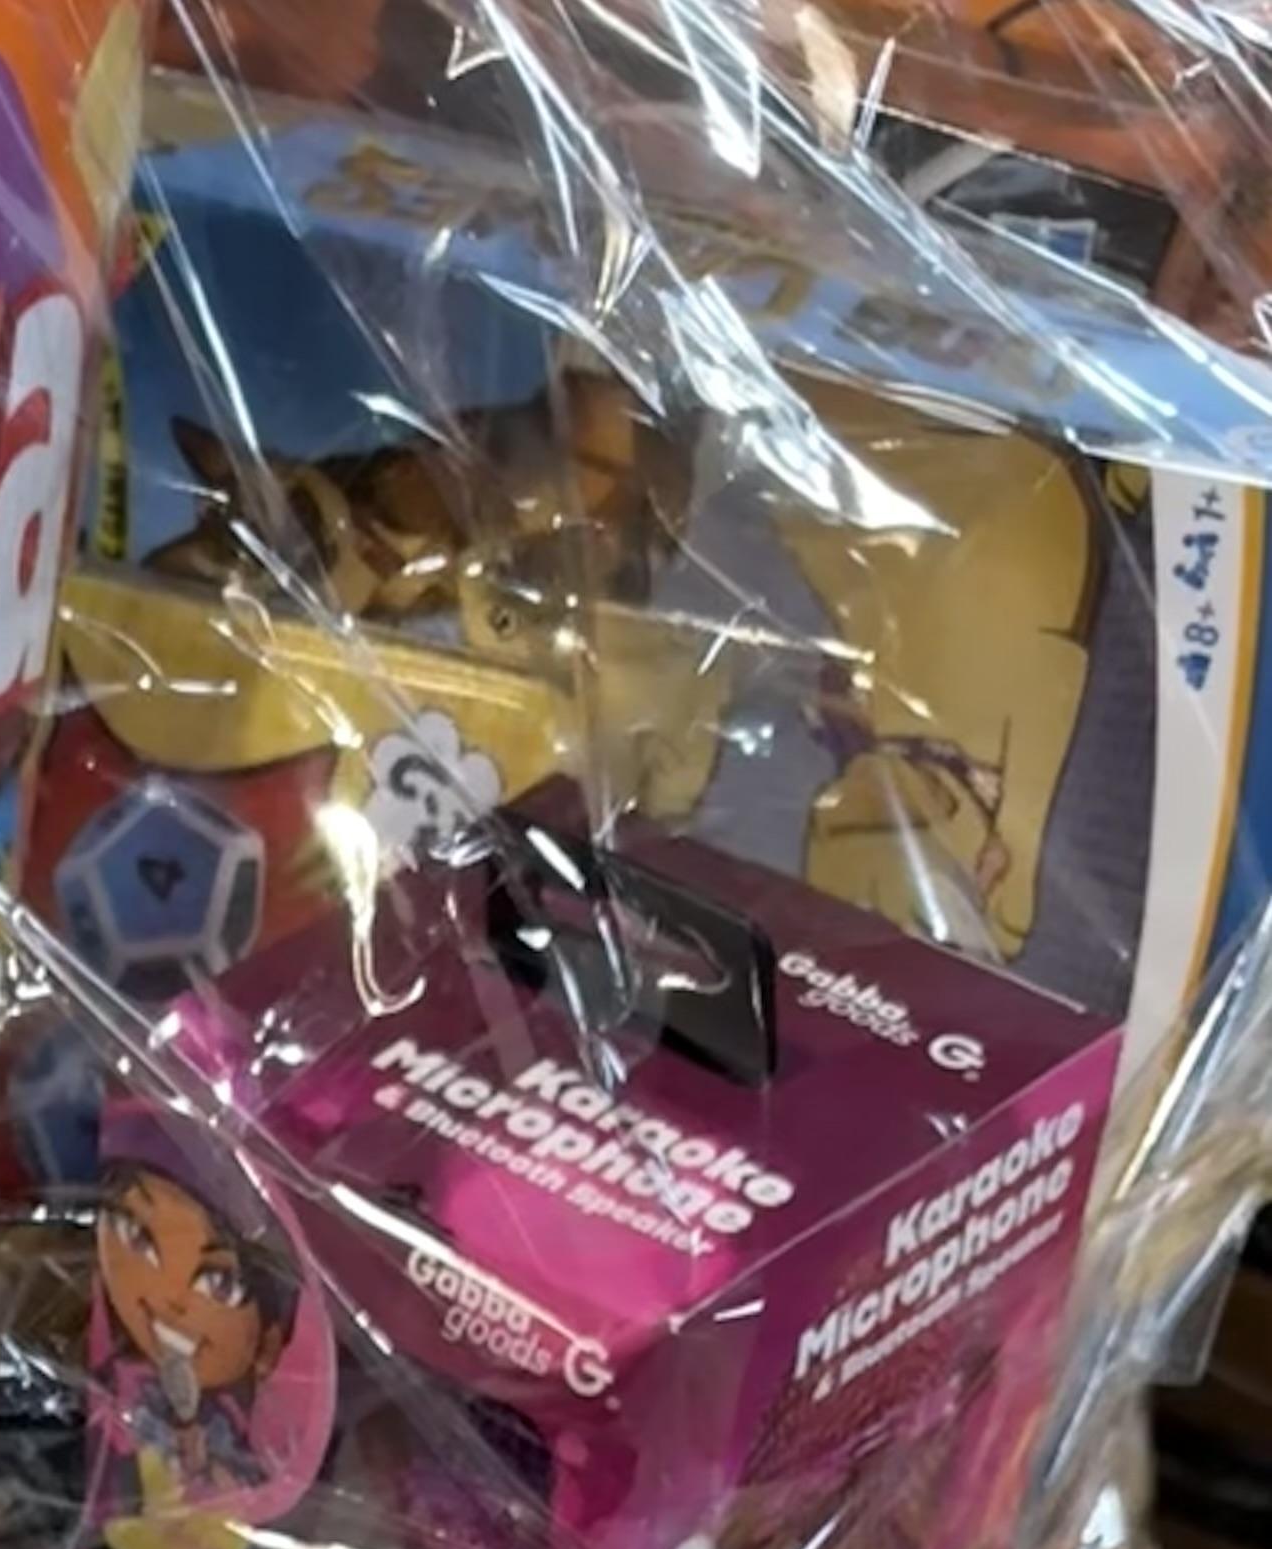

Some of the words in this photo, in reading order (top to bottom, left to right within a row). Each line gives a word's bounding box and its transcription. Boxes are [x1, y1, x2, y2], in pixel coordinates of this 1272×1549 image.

[778, 953, 907, 1022] Gabba
[370, 1038, 753, 1233] Microphone
[404, 1100, 567, 1193] Bluetooth
[515, 1059, 794, 1207] Karaoke
[884, 1102, 1085, 1267] Karaoke
[407, 1246, 531, 1336] Gabba
[793, 1158, 1074, 1380] Microphone
[441, 1306, 553, 1376] goods
